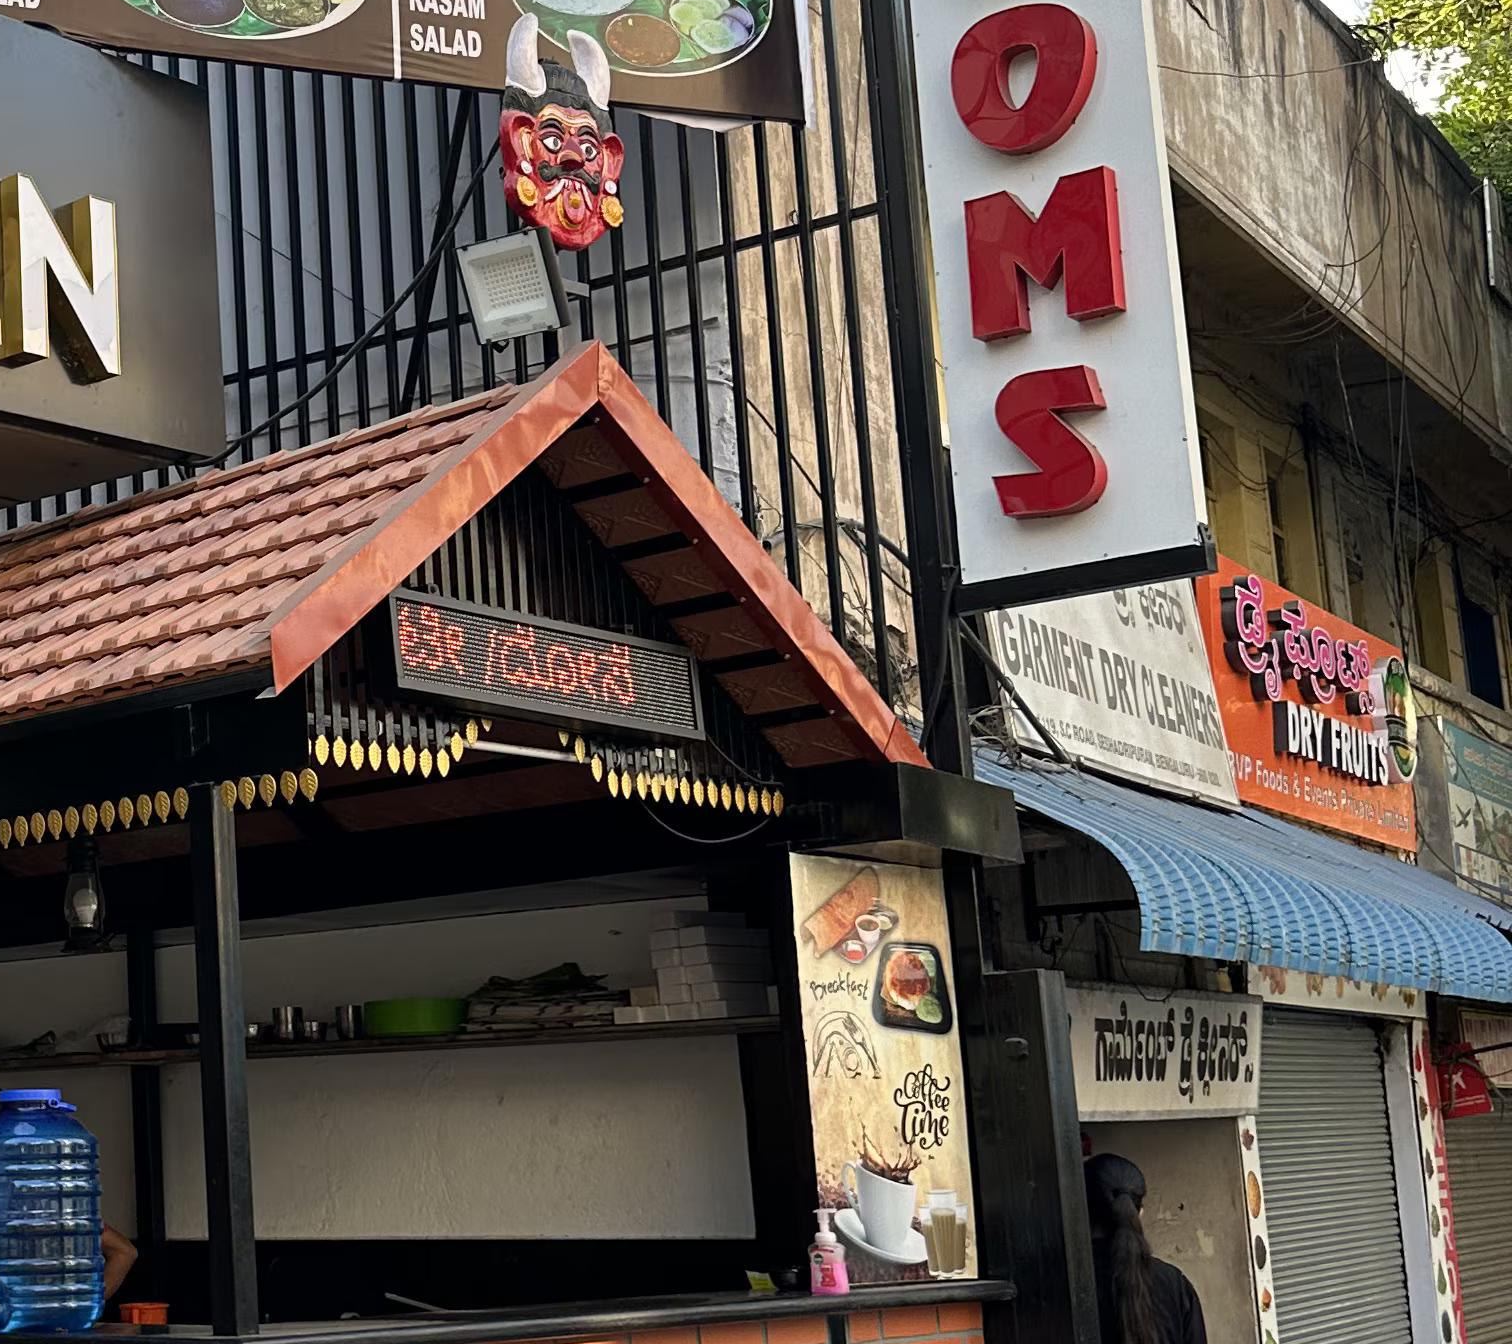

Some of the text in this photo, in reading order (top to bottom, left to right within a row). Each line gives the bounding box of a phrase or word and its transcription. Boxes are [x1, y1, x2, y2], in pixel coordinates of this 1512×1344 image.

[410, 23, 482, 58] SALAD
[997, 609, 1099, 705] GARMENT
[1098, 647, 1141, 719] DRY
[1141, 664, 1224, 752] CLEANERS
[1287, 701, 1325, 762] DRY
[1330, 717, 1389, 786] FRUITS
[1255, 759, 1289, 794] Foods
[1303, 776, 1338, 811] Events
[809, 970, 869, 1002] Breakfast
[893, 1062, 951, 1113] Coffee
[900, 1099, 950, 1151] Time
